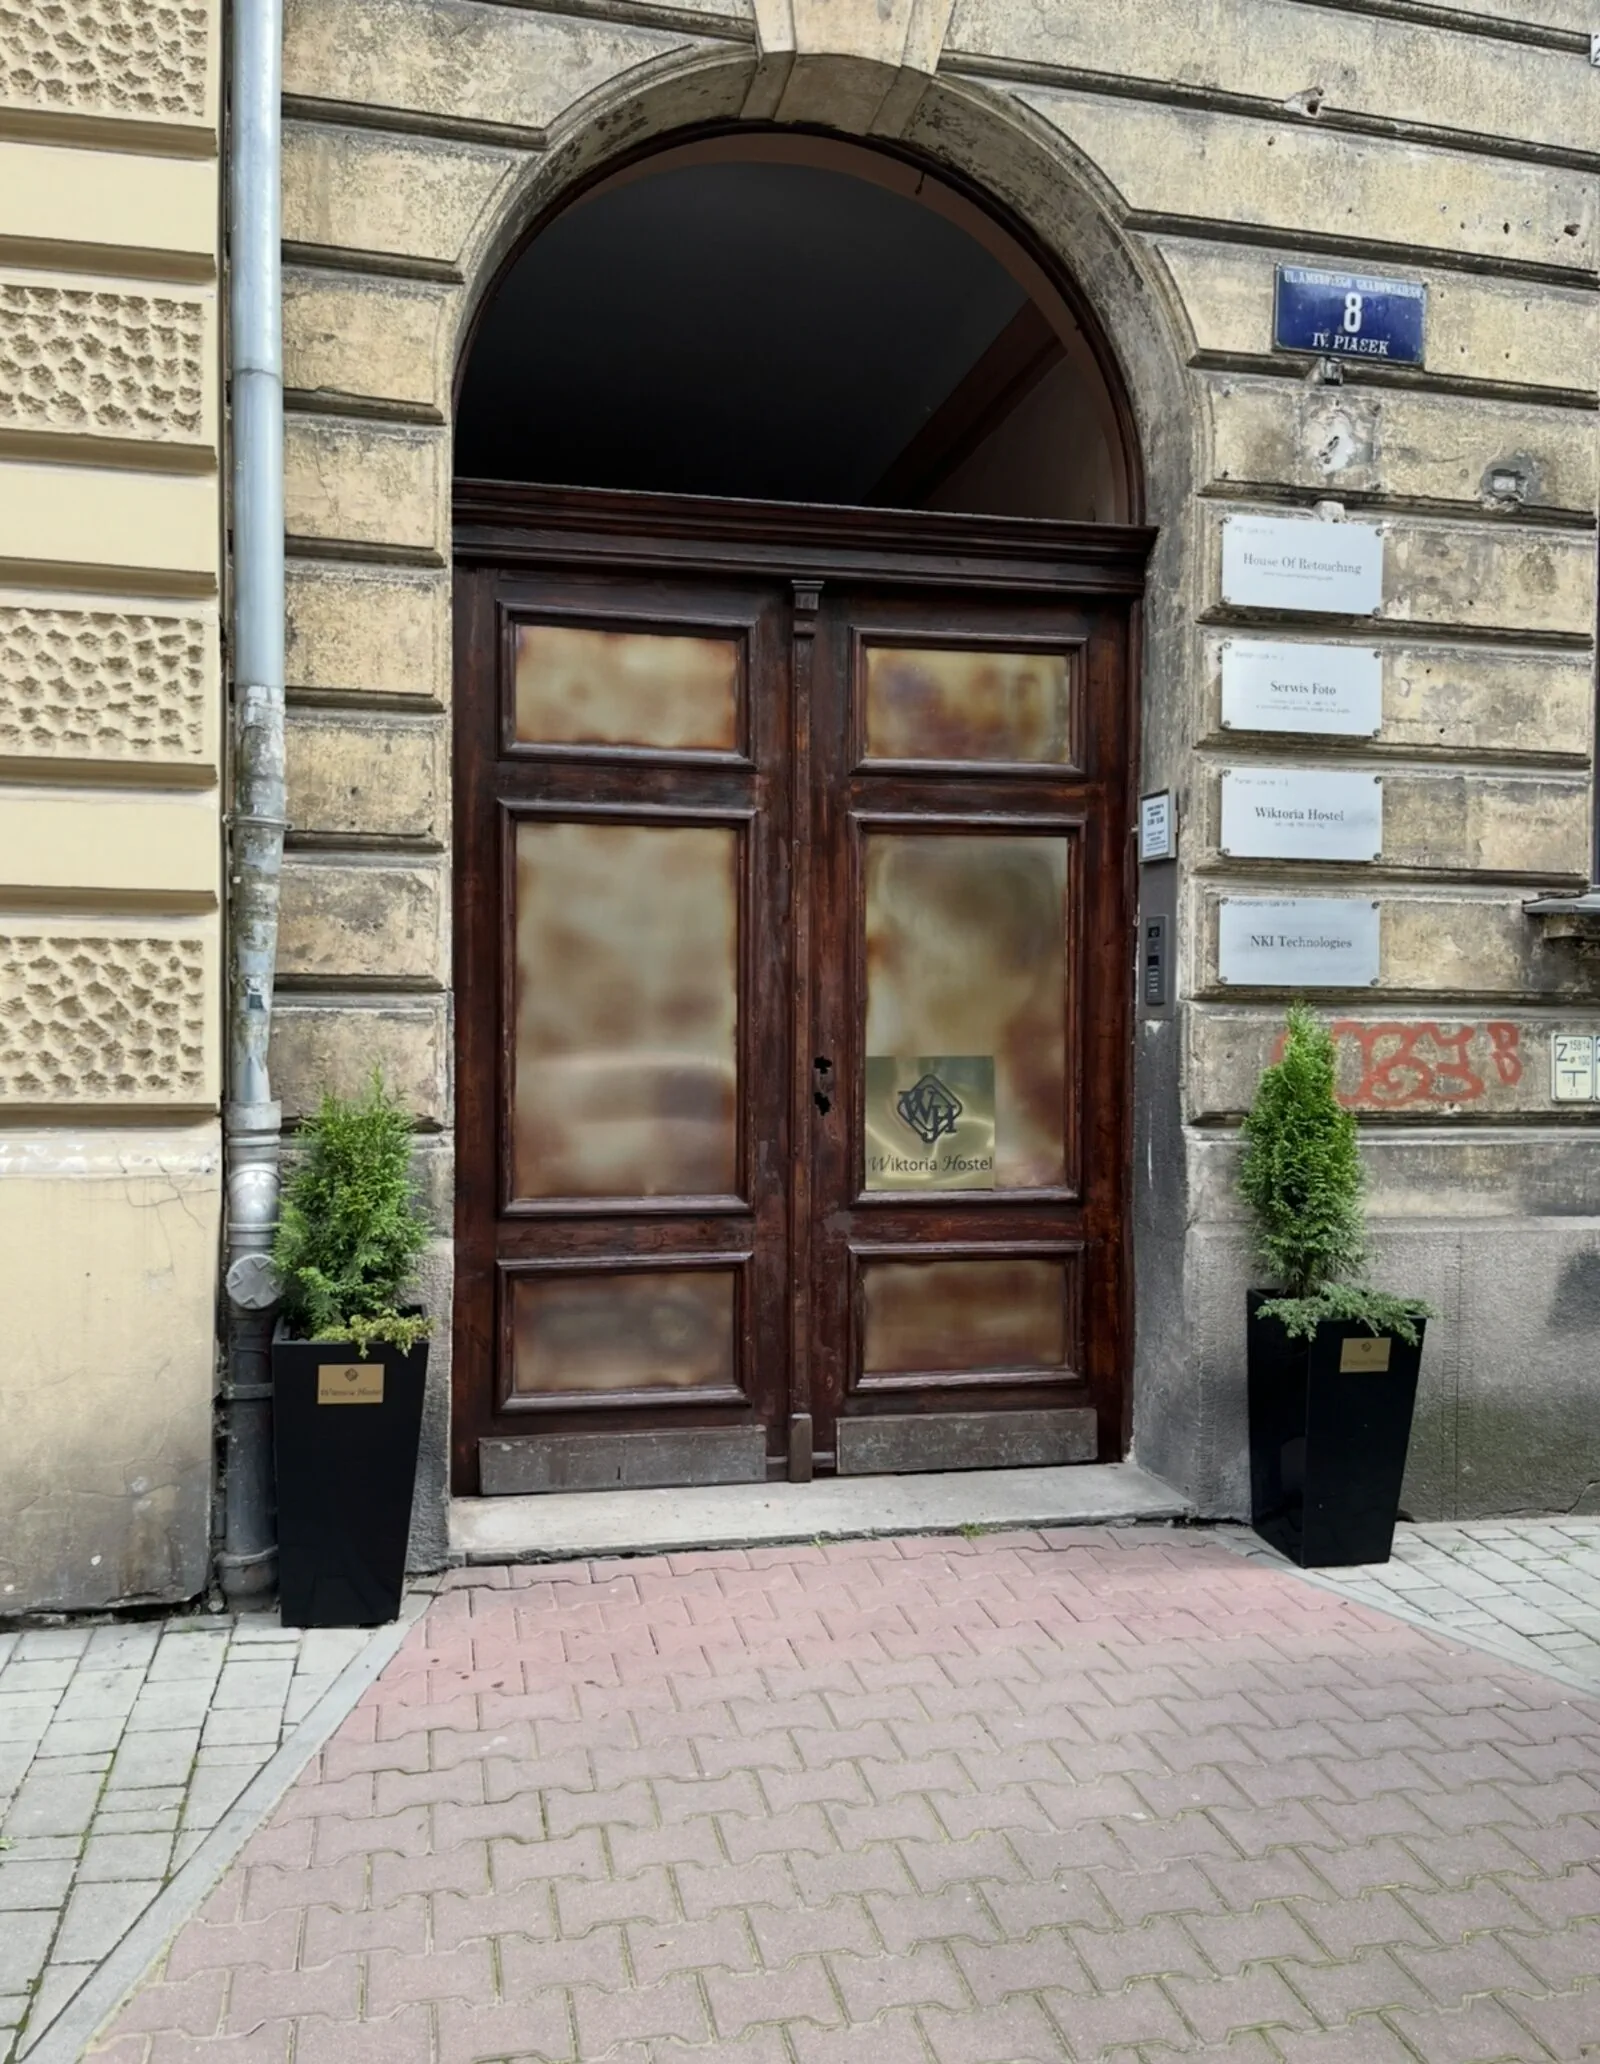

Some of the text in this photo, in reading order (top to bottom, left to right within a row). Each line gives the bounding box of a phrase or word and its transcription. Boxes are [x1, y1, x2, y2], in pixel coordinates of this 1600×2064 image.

[1344, 292, 1363, 333] 8
[1333, 334, 1389, 355] PIASEK
[1243, 553, 1362, 575] House Of Retouching
[1270, 681, 1337, 695] Serwis Foto
[1254, 806, 1344, 821] Wiktoria Hostel
[1250, 935, 1352, 949] NKI Technologies
[1556, 1043, 1567, 1061] Z
[869, 1154, 993, 1171] Wiktoria Hostel
